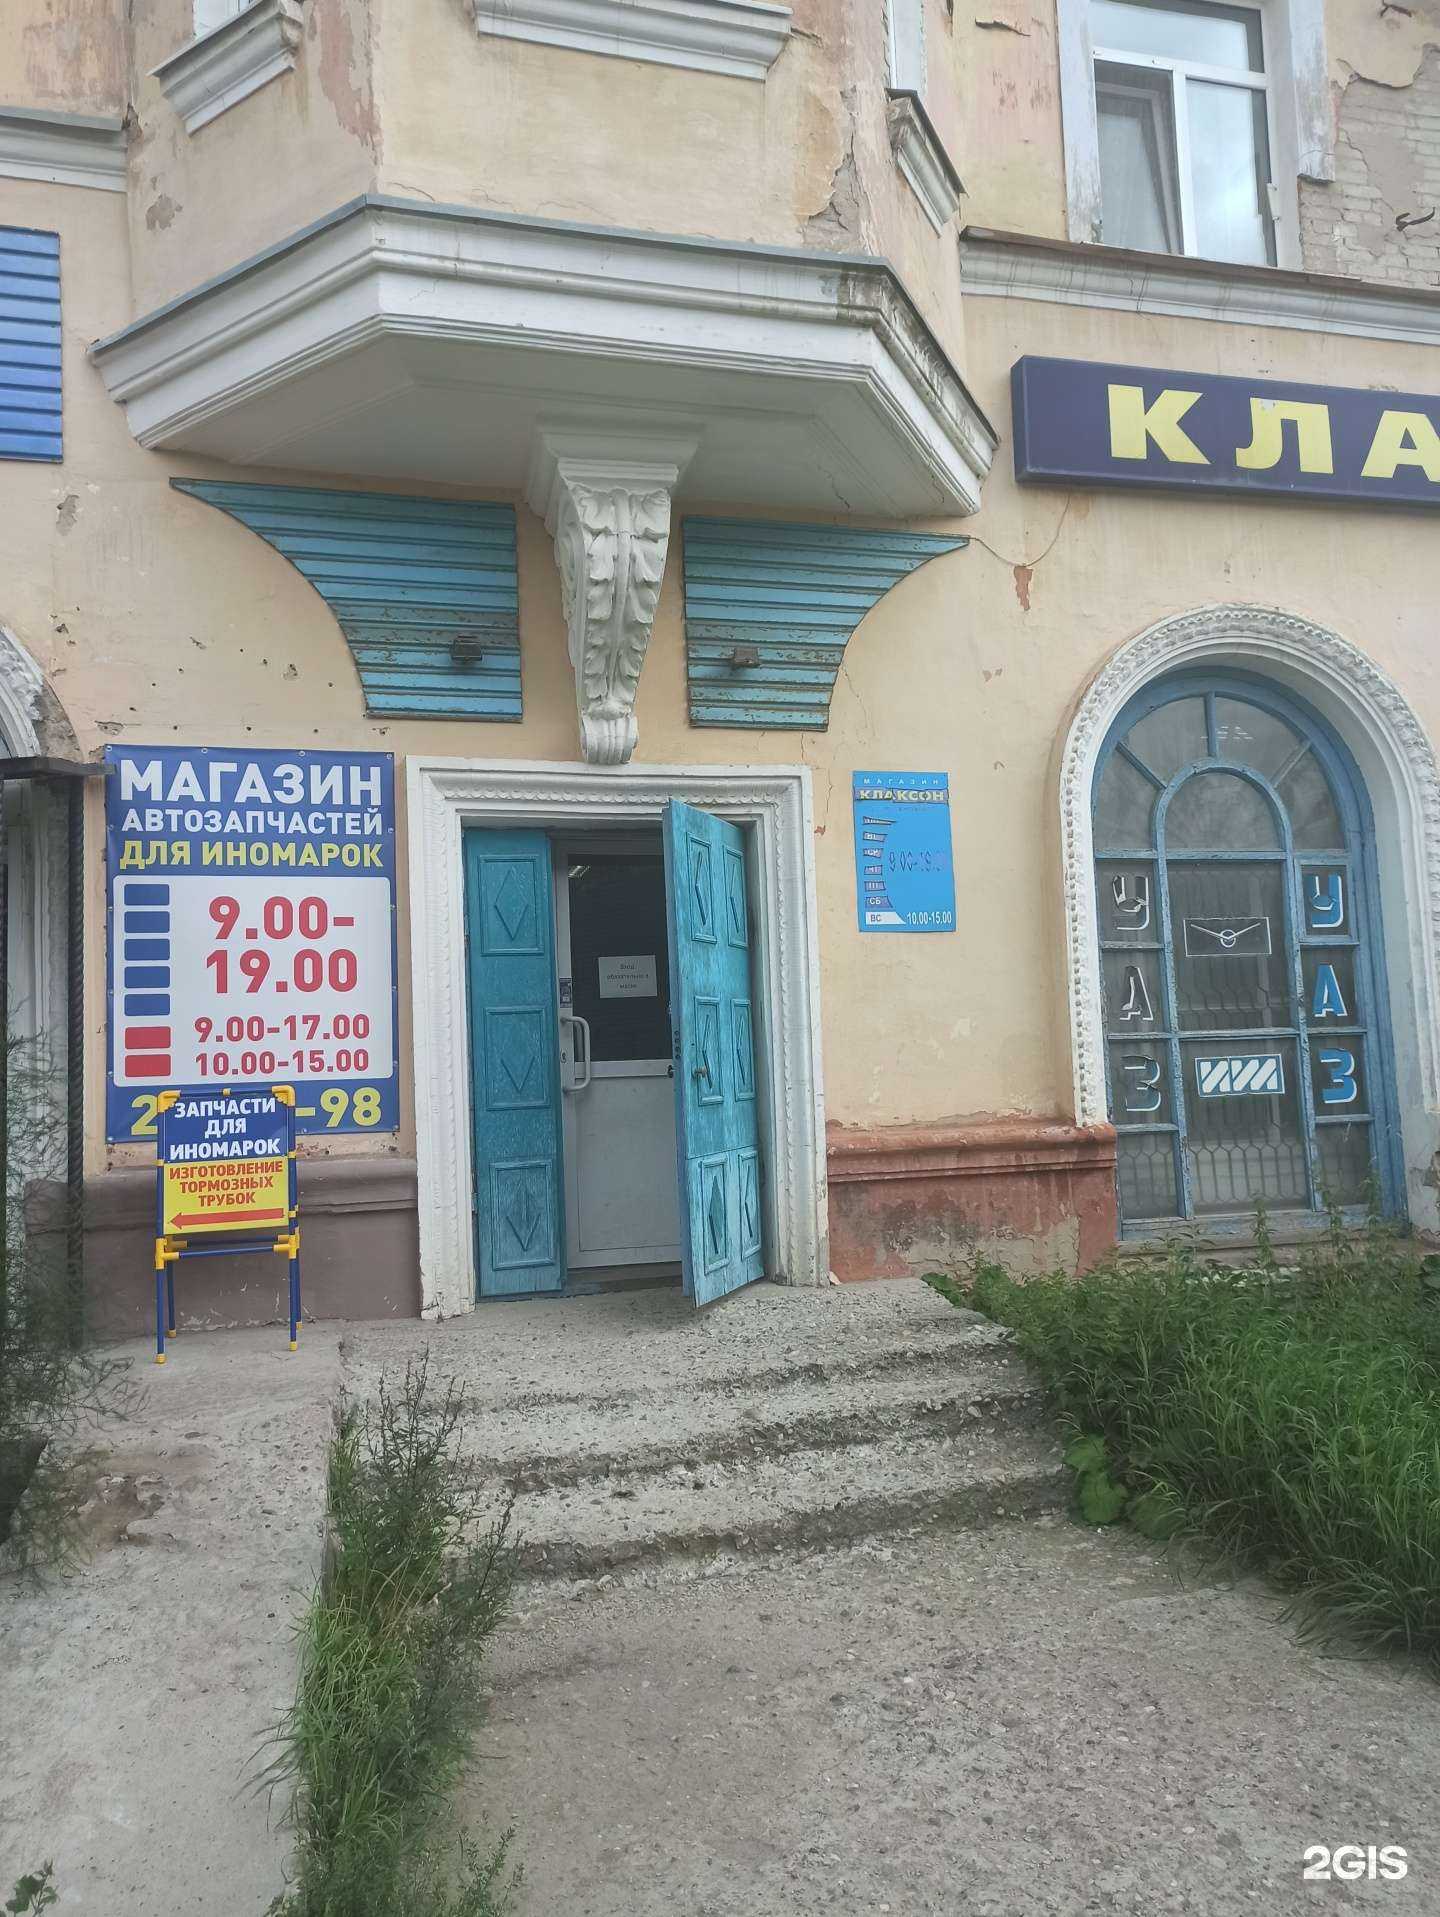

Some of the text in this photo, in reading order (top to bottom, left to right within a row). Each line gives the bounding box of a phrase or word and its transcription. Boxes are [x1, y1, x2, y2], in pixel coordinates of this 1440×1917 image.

[1107, 383, 1440, 484] КЛА
[120, 760, 382, 806] МАГАЗИН
[860, 789, 944, 801] КЛАКСОН
[121, 805, 383, 835] АВТОЗАПЧАСТЕЙ
[120, 840, 384, 869] ДЛЯ ИНОМАРОК
[208, 896, 355, 940] 9.00-
[206, 949, 358, 993] 19.00
[194, 1014, 370, 1042] 9.00-17.00
[195, 1049, 369, 1076] 10.00-15.00
[174, 1098, 276, 1118] ЗАПЧАСТИ
[204, 1118, 247, 1139] ДЛЯ
[170, 1138, 281, 1160] ИНОМАРОК
[169, 1160, 283, 1180] ИЗГОТОВЛЕНИЕ
[179, 1176, 274, 1194] ТОРМОЗНЫХ
[198, 1192, 256, 1207] ТРУБОК
